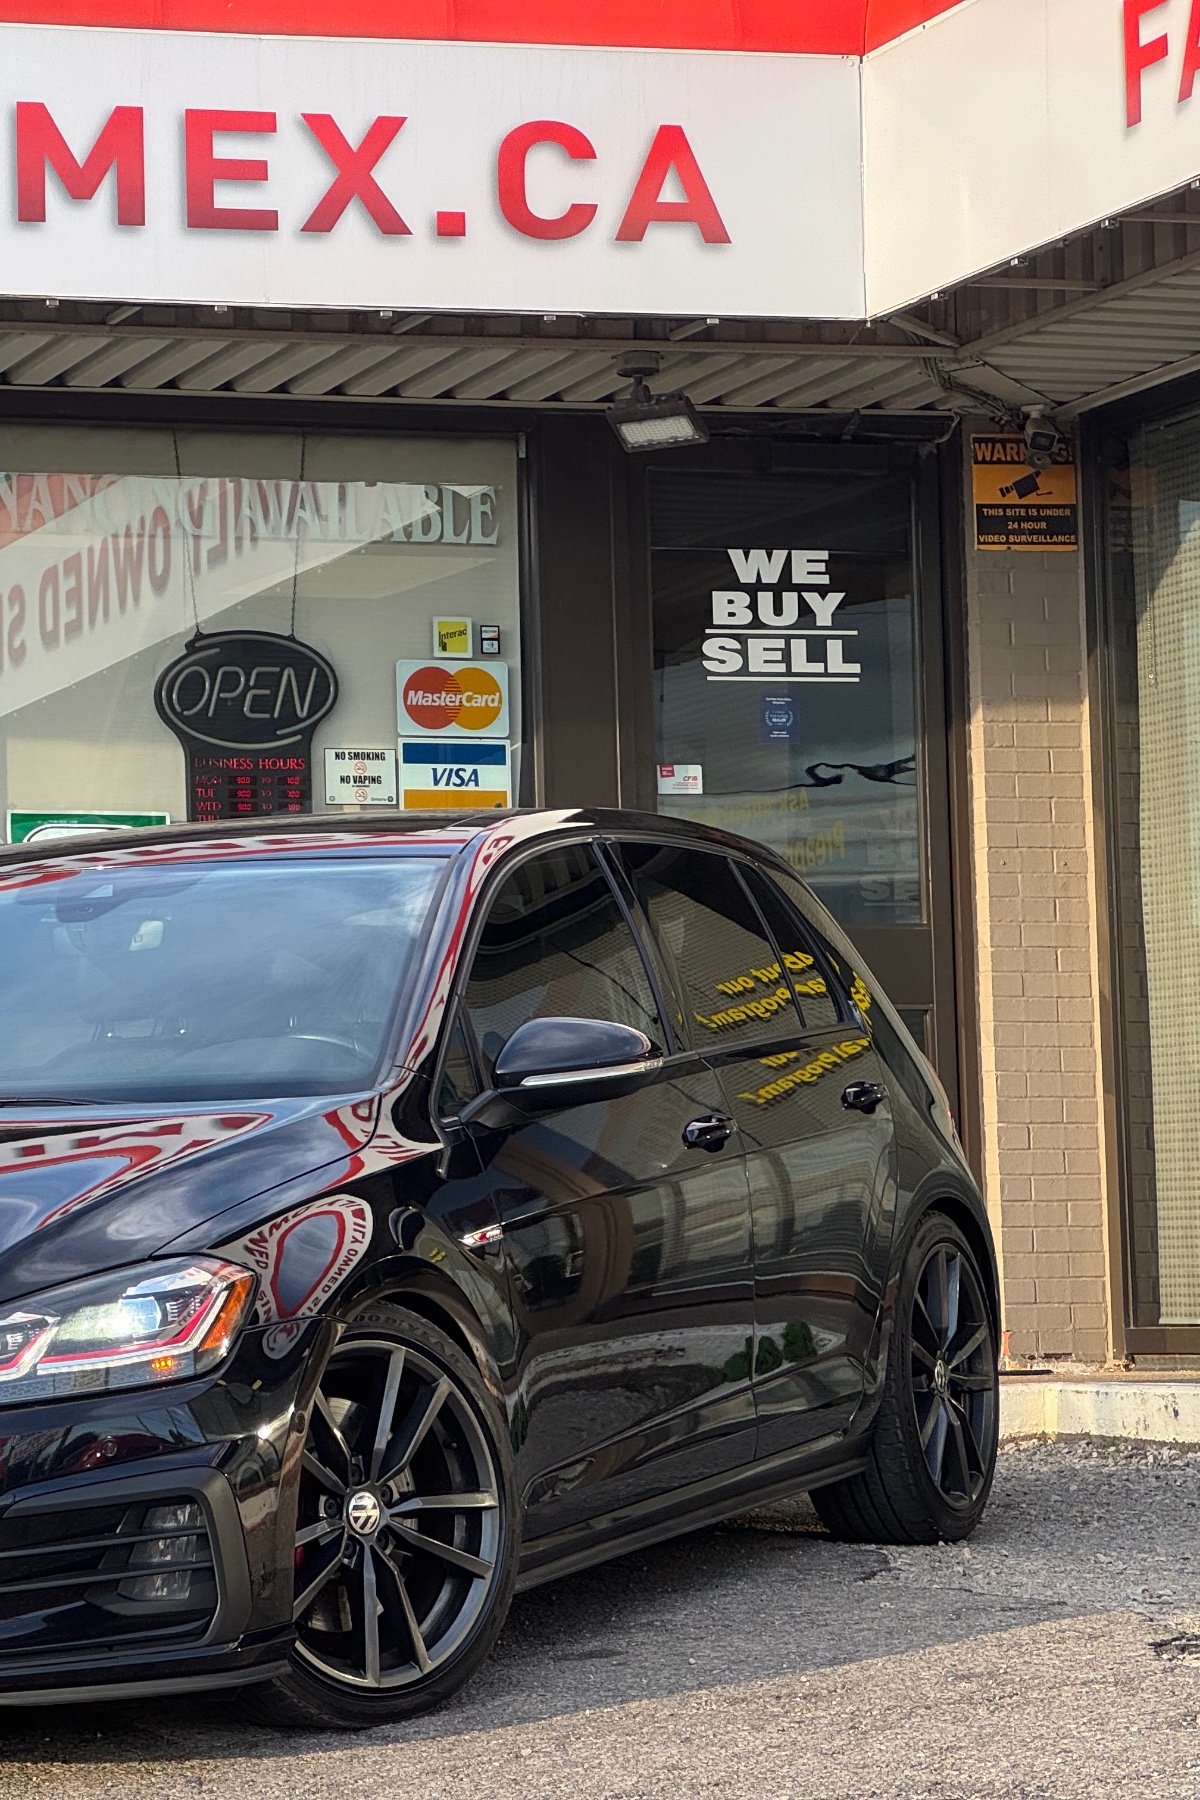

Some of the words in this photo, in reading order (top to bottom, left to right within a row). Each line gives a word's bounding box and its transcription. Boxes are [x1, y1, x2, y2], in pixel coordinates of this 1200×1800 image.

[974, 442, 1073, 461] WARNG!
[236, 480, 500, 544] AVAILABLE
[982, 508, 1004, 516] THIS
[1006, 508, 1026, 516] SITE
[1028, 508, 1038, 516] IS
[1040, 508, 1071, 516] UNDER
[1007, 521, 1018, 530] 24
[1021, 521, 1047, 529] HOUR
[979, 534, 1006, 543] VIDEO
[1008, 534, 1076, 543] SURVEILLANCE
[726, 548, 830, 585] WE
[711, 590, 847, 627] BUY
[438, 628, 468, 644] Interac
[701, 637, 862, 674] SELL
[172, 665, 318, 720] OPEN
[406, 689, 502, 708] MasterCard
[194, 757, 254, 770] BUSINESS
[258, 757, 306, 770] HOURS
[334, 751, 346, 761] NO
[347, 751, 386, 761] SMOKING
[340, 775, 351, 784] NO
[352, 775, 382, 784] VAPING
[430, 767, 480, 787] VISA
